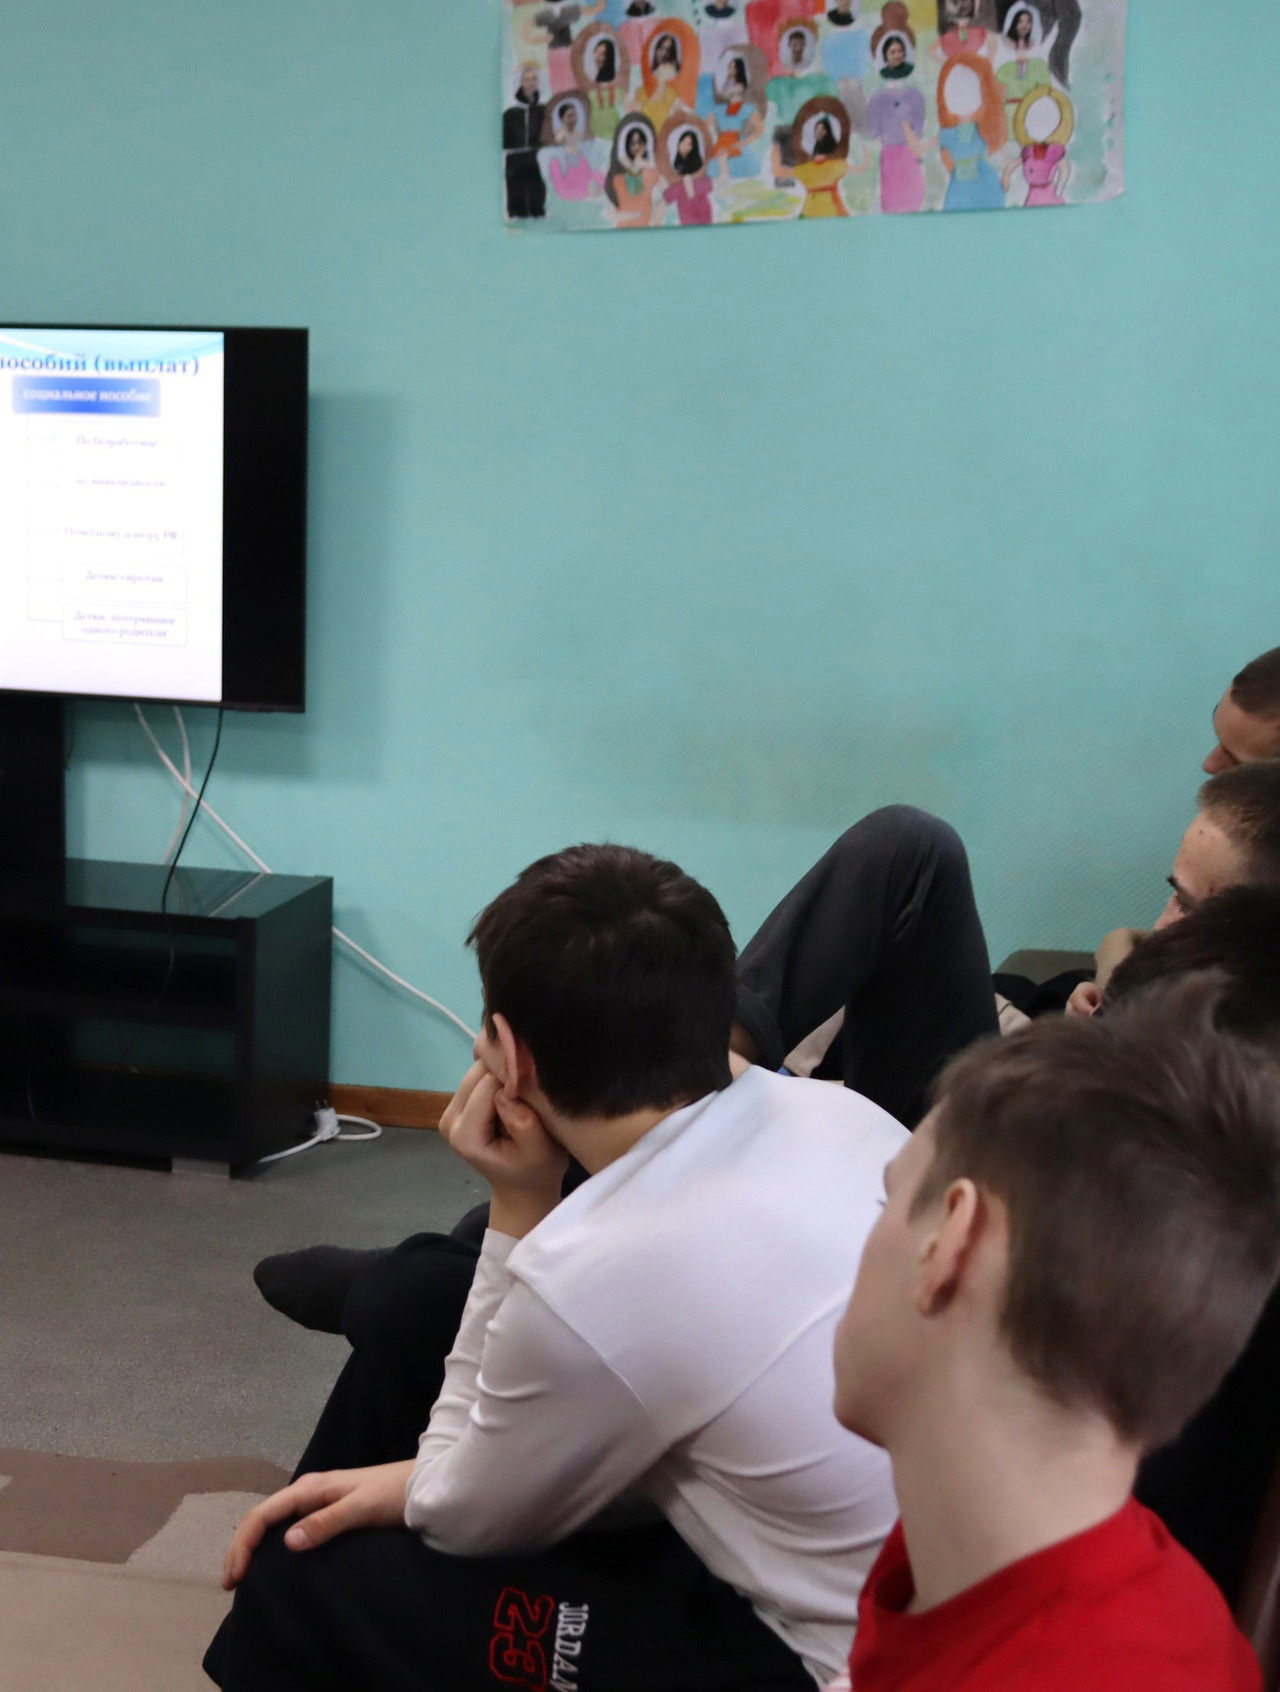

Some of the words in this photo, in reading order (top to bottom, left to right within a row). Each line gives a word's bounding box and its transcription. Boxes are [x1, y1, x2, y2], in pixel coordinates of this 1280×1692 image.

[94, 354, 199, 376] (выплат)
[489, 1586, 556, 1692] 23
[550, 1601, 589, 1692] JORDAN
